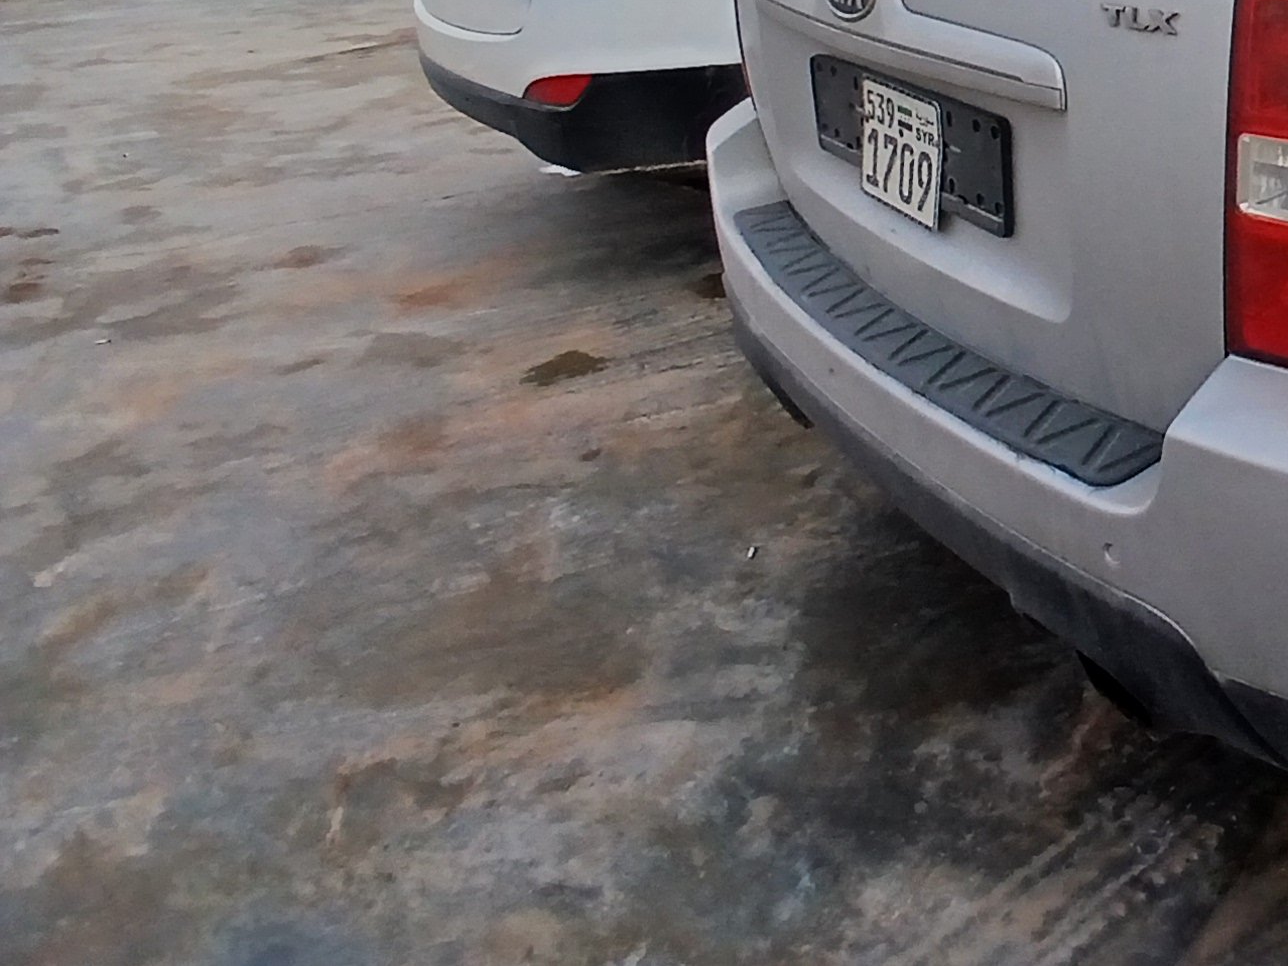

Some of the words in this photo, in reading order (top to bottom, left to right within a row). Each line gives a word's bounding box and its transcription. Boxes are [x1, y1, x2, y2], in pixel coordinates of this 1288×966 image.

[1100, 2, 1181, 36] TLX
[867, 89, 895, 129] 539
[915, 127, 935, 147] SYR
[866, 128, 933, 212] 1709
